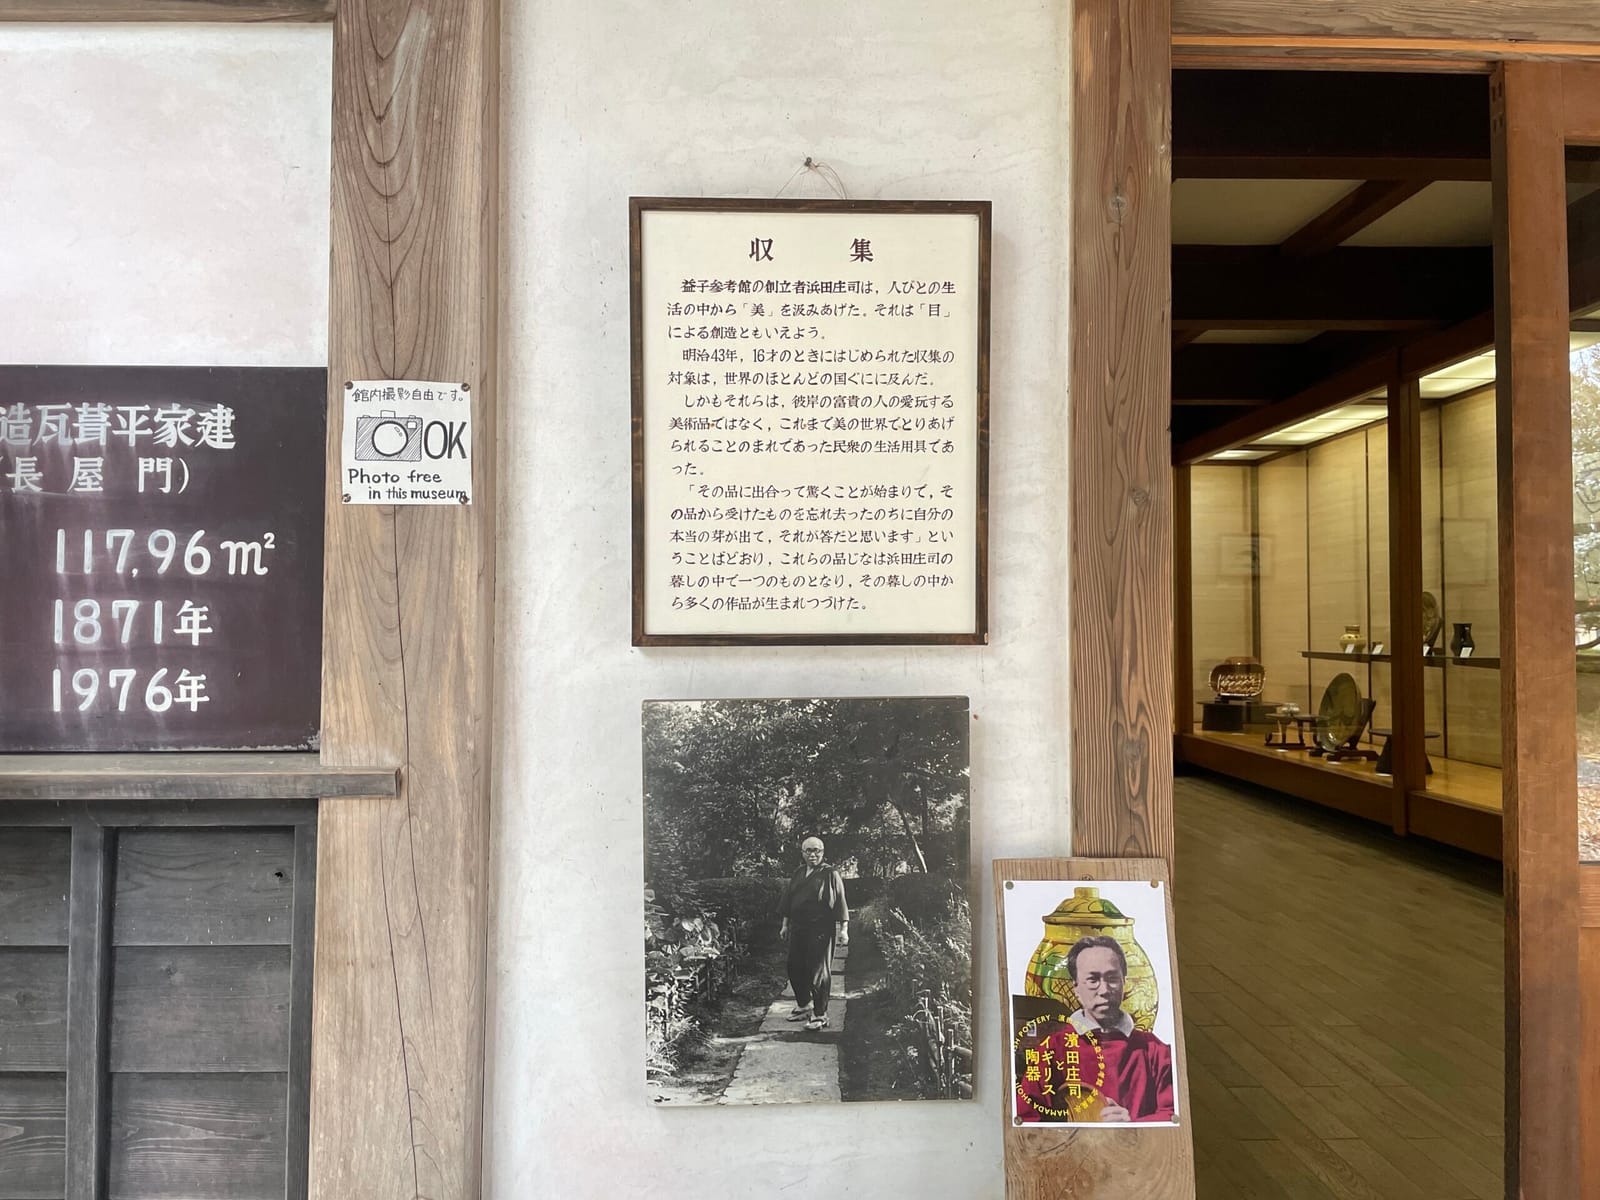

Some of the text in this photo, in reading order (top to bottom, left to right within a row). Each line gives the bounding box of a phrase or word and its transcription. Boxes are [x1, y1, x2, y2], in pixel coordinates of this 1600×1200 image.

[423, 420, 467, 460] OK
[348, 468, 442, 484] Photo free
[671, 462, 704, 477] った。
[368, 486, 381, 500] in
[386, 486, 407, 500] this
[53, 598, 213, 645] 1871年
[51, 667, 210, 712] 1976年
[1025, 1049, 1041, 1082] 陶器
[1040, 1035, 1056, 1096] イギリス
[1033, 1102, 1069, 1117] HAMADA
